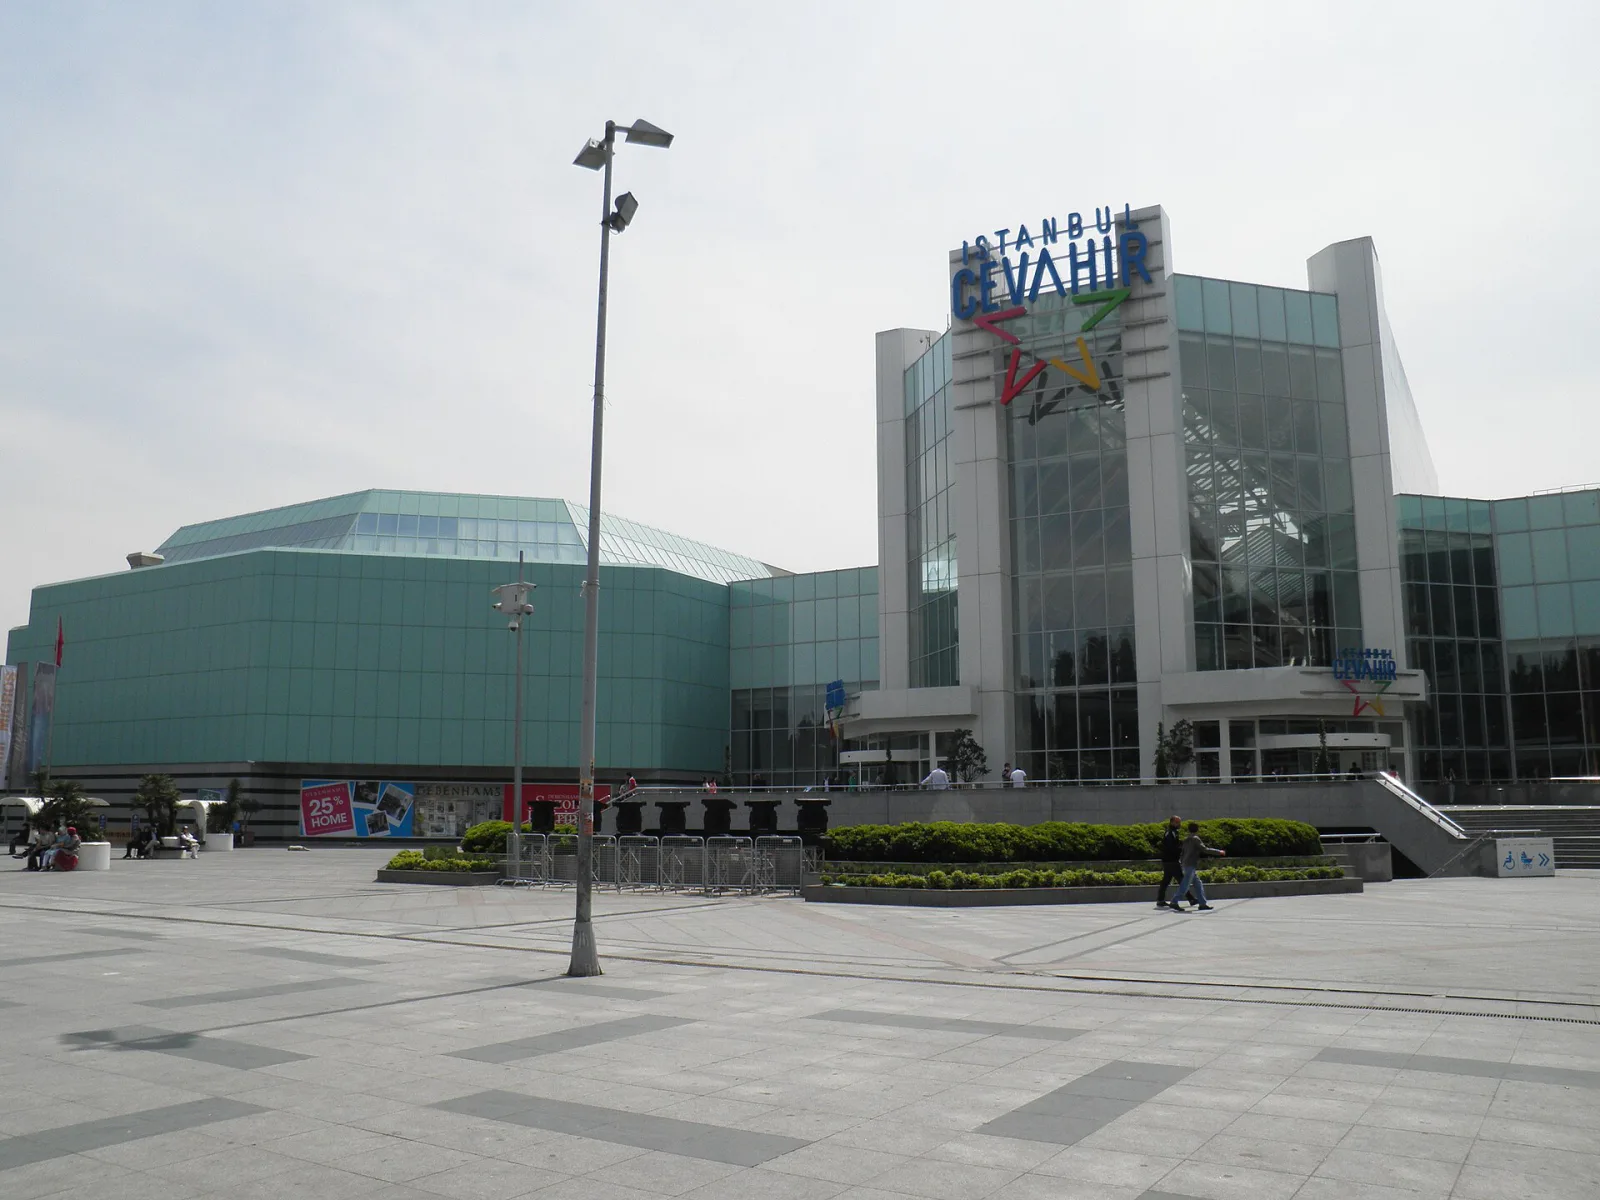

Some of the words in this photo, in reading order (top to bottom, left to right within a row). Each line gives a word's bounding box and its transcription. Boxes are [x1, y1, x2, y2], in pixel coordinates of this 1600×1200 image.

[962, 203, 1139, 266] ISTANBUL
[415, 785, 501, 797] DEBENHAMS
[309, 795, 344, 816] 25%
[311, 812, 348, 828] HOME
